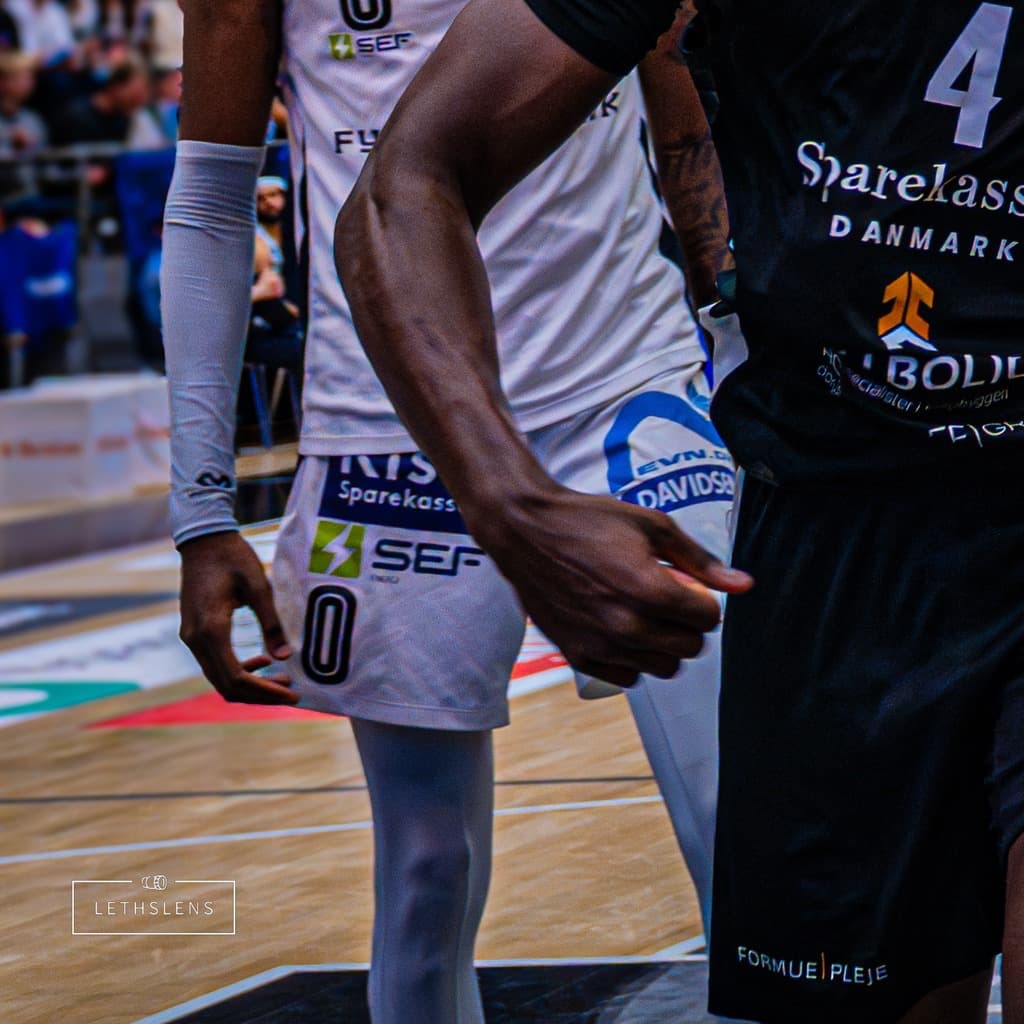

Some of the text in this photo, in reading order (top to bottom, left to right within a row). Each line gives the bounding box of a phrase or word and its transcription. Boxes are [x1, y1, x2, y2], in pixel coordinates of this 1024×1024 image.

[356, 33, 414, 54] SEF
[924, 2, 1013, 149] 4
[829, 213, 1020, 263] DANMARK
[372, 539, 487, 577] SEF
[302, 586, 358, 685] 0
